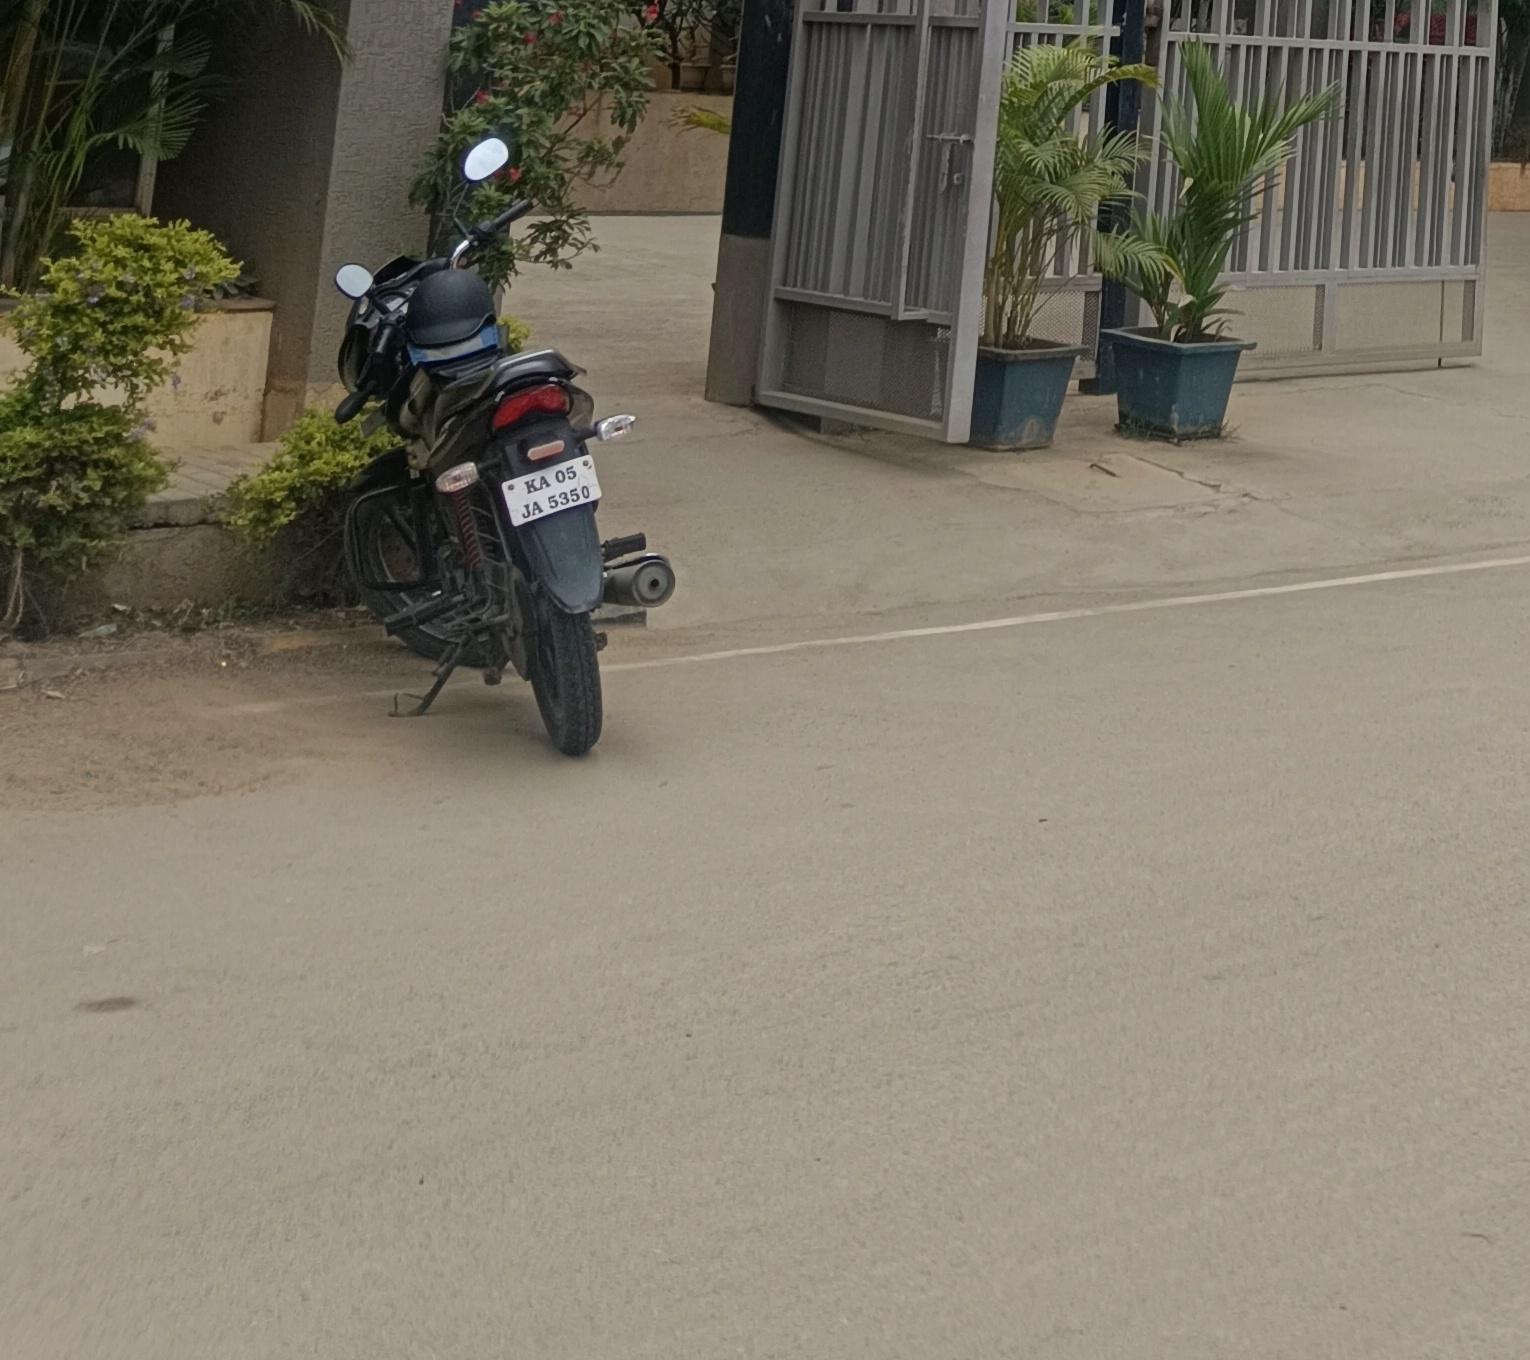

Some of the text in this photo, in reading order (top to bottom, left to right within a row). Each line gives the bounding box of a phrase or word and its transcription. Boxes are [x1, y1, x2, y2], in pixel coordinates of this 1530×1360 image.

[525, 466, 577, 495] KA 05
[522, 485, 590, 519] JA 5350
